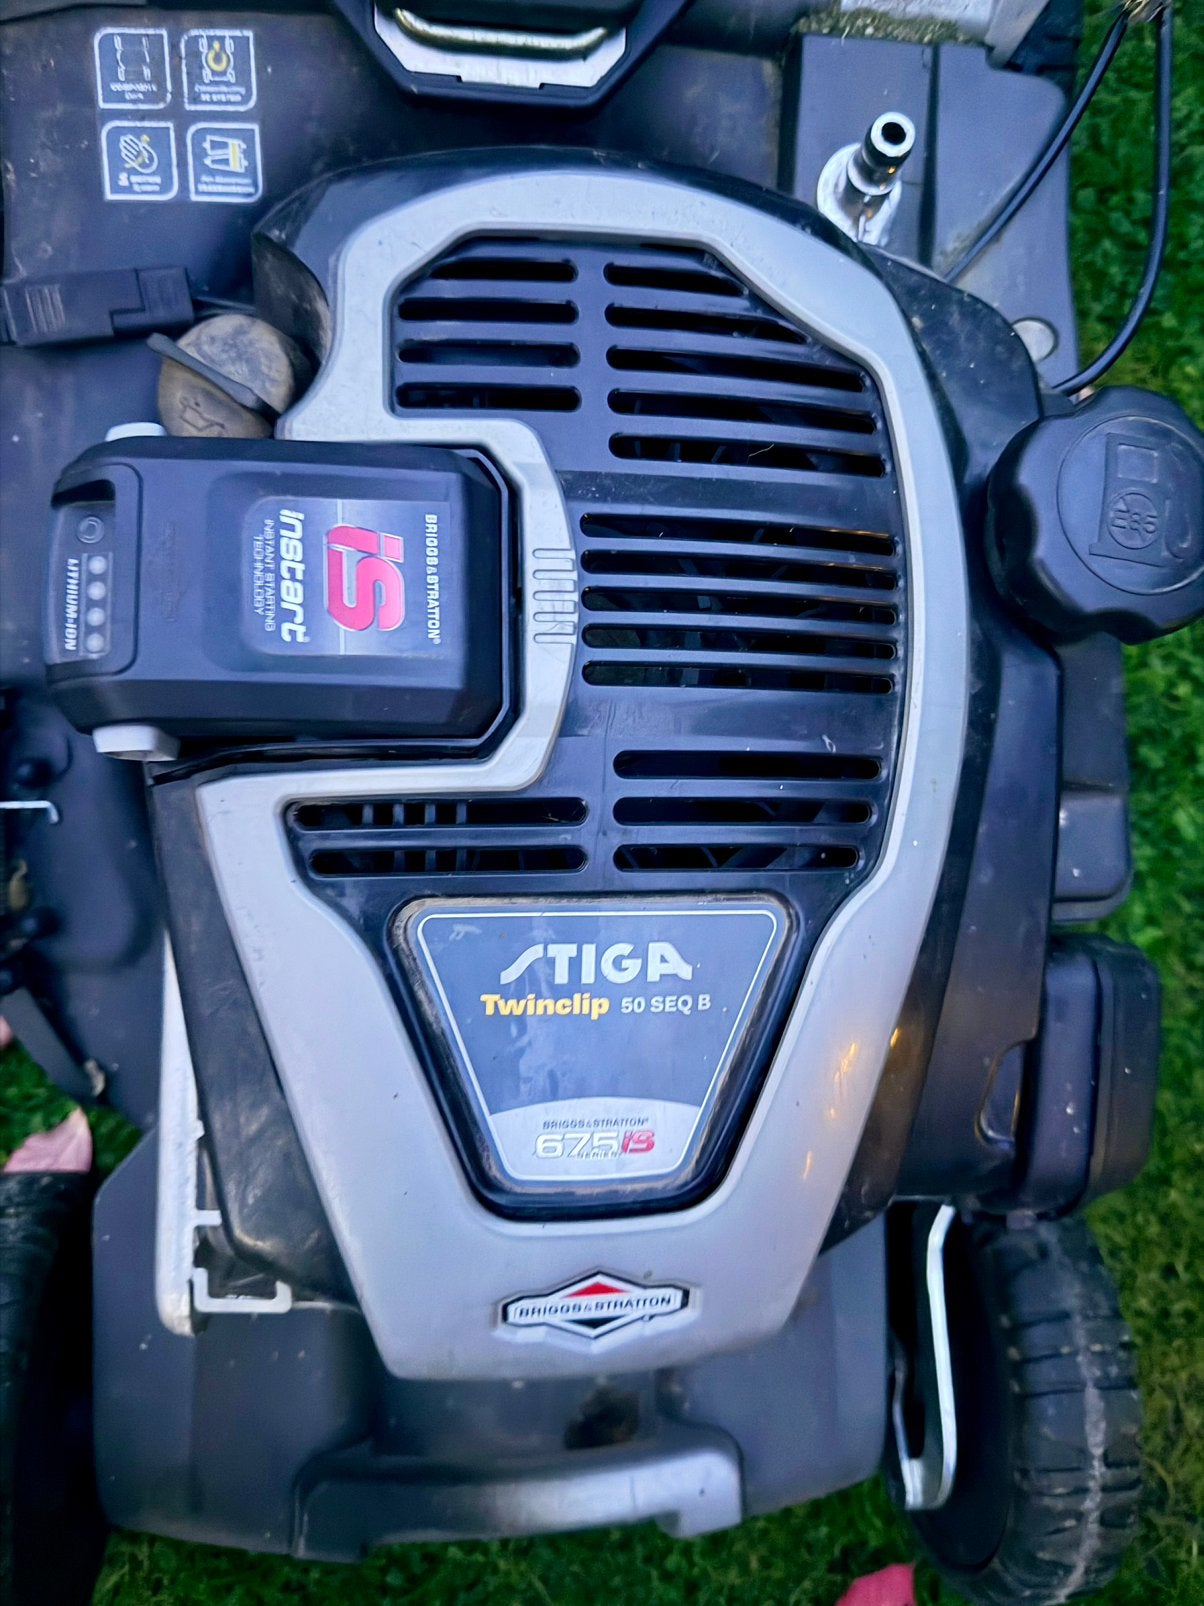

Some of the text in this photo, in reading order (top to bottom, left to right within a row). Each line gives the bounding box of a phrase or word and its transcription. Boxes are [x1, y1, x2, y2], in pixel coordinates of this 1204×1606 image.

[253, 536, 264, 615] TECHNOLOGY
[264, 520, 276, 631] INSTANT STARTING
[500, 941, 693, 985] STIGA
[480, 993, 711, 1020] Twinclip 50 SEQ B
